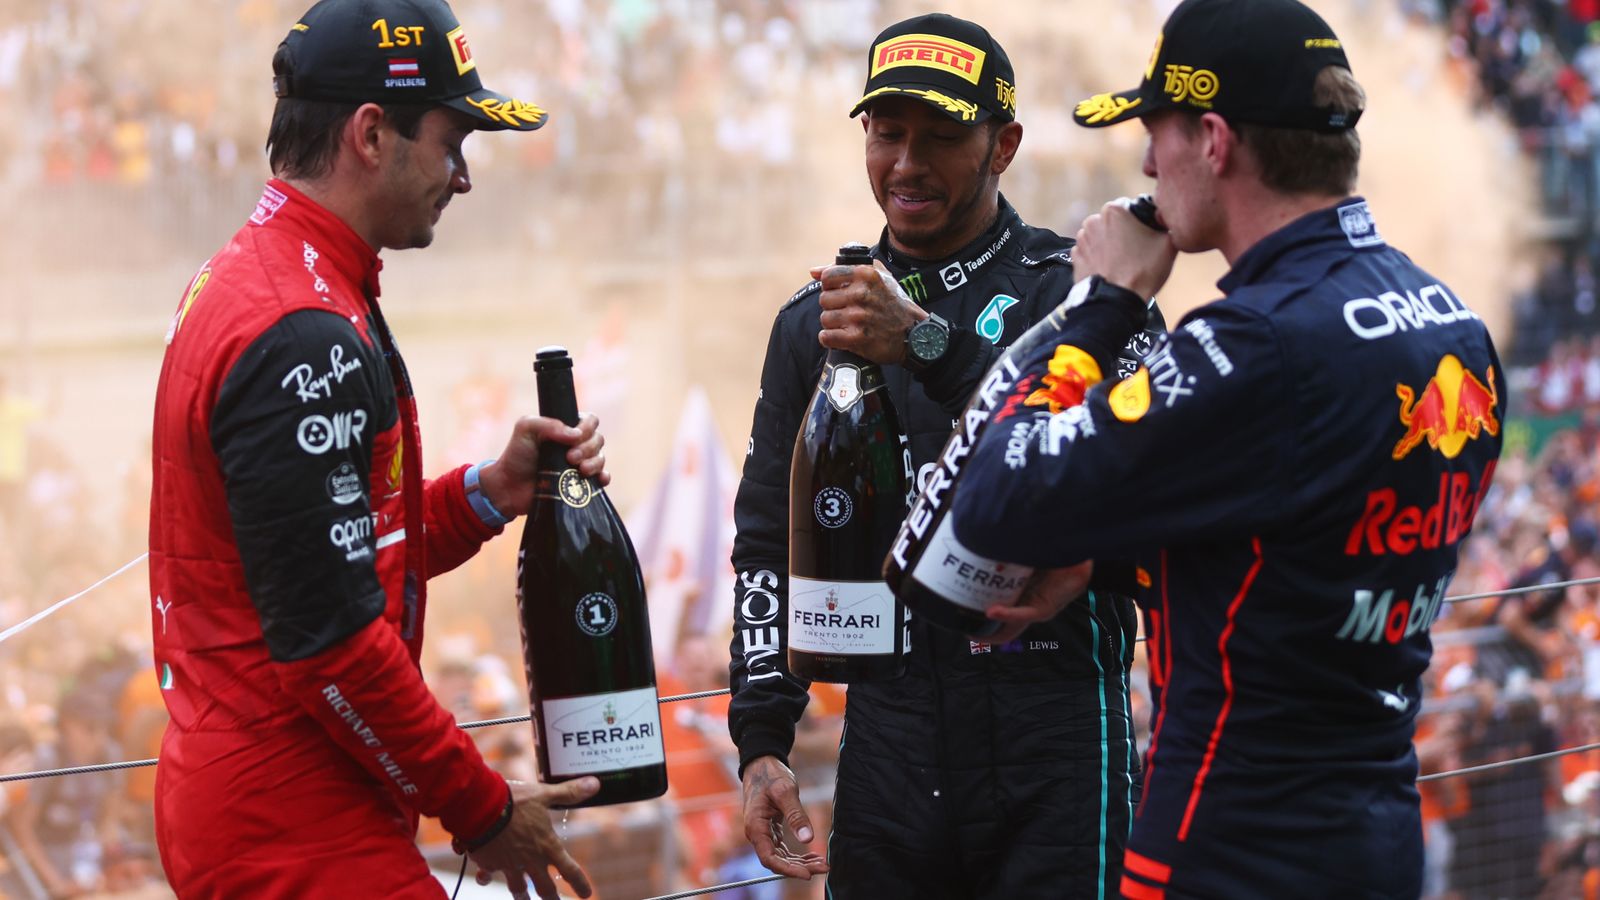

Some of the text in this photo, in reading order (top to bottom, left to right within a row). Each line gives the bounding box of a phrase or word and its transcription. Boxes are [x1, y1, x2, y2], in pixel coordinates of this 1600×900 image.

[372, 19, 424, 48] 1ST
[878, 40, 975, 74] PIRELLI
[385, 78, 426, 87] SPIELBERG
[892, 356, 1020, 570] FERRARI
[825, 497, 840, 517] 3
[589, 603, 605, 625] 1
[795, 610, 880, 628] FERRARI
[1335, 575, 1448, 644] Mobil
[741, 569, 783, 683] INEOS
[804, 630, 838, 638] TRENTO
[1030, 641, 1059, 650] LEWIS
[562, 722, 654, 747] FERRARI
[581, 747, 621, 757] TRENTO
[376, 752, 418, 795] MILLE
